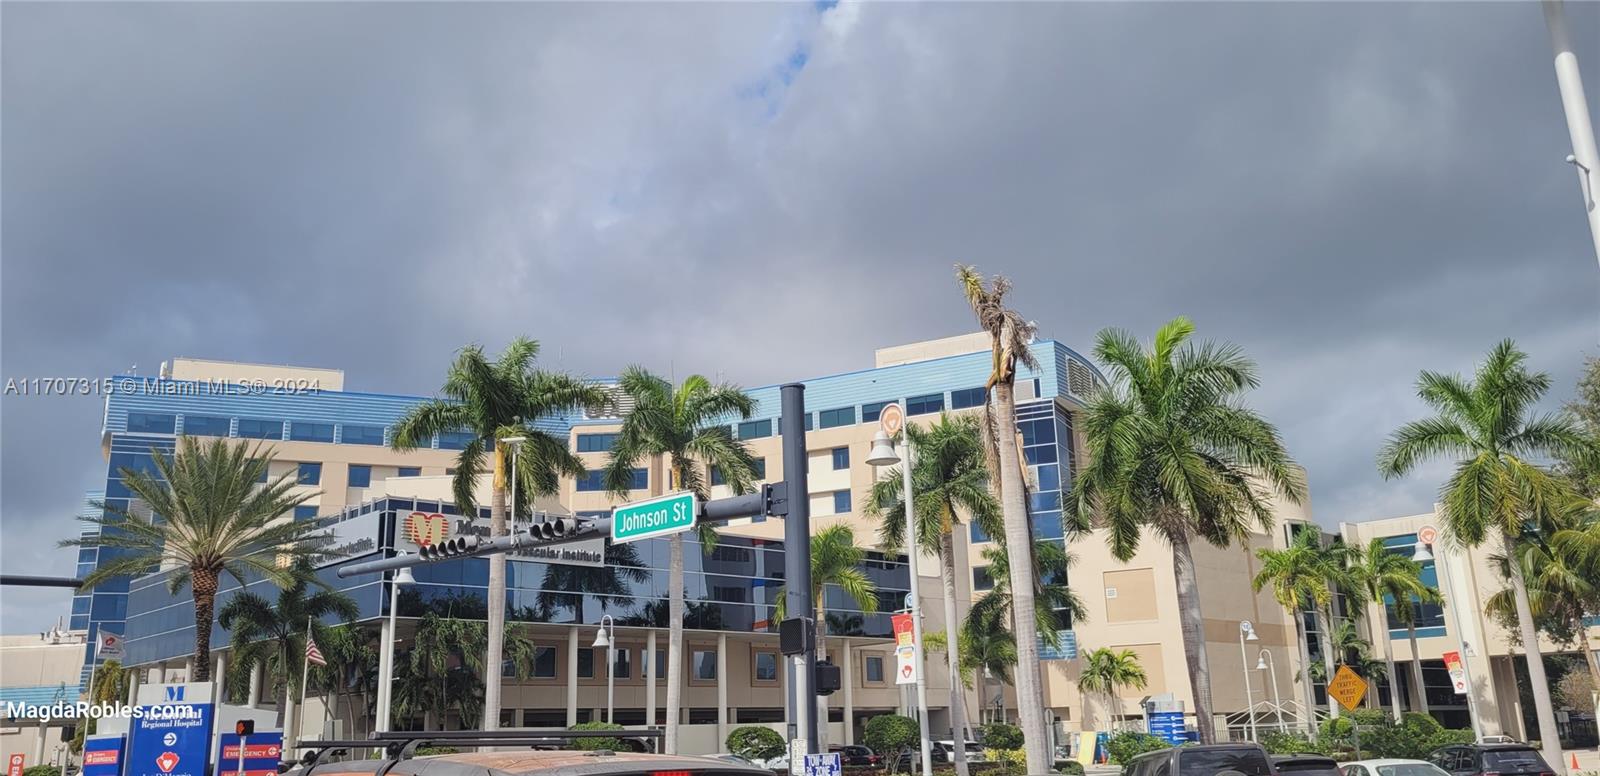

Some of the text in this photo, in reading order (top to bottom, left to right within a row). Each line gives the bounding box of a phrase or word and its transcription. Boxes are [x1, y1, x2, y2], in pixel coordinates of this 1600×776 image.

[619, 501, 686, 533] Johnson St
[141, 718, 203, 730] Regional Hospital
[225, 750, 267, 758] EMEGENCY
